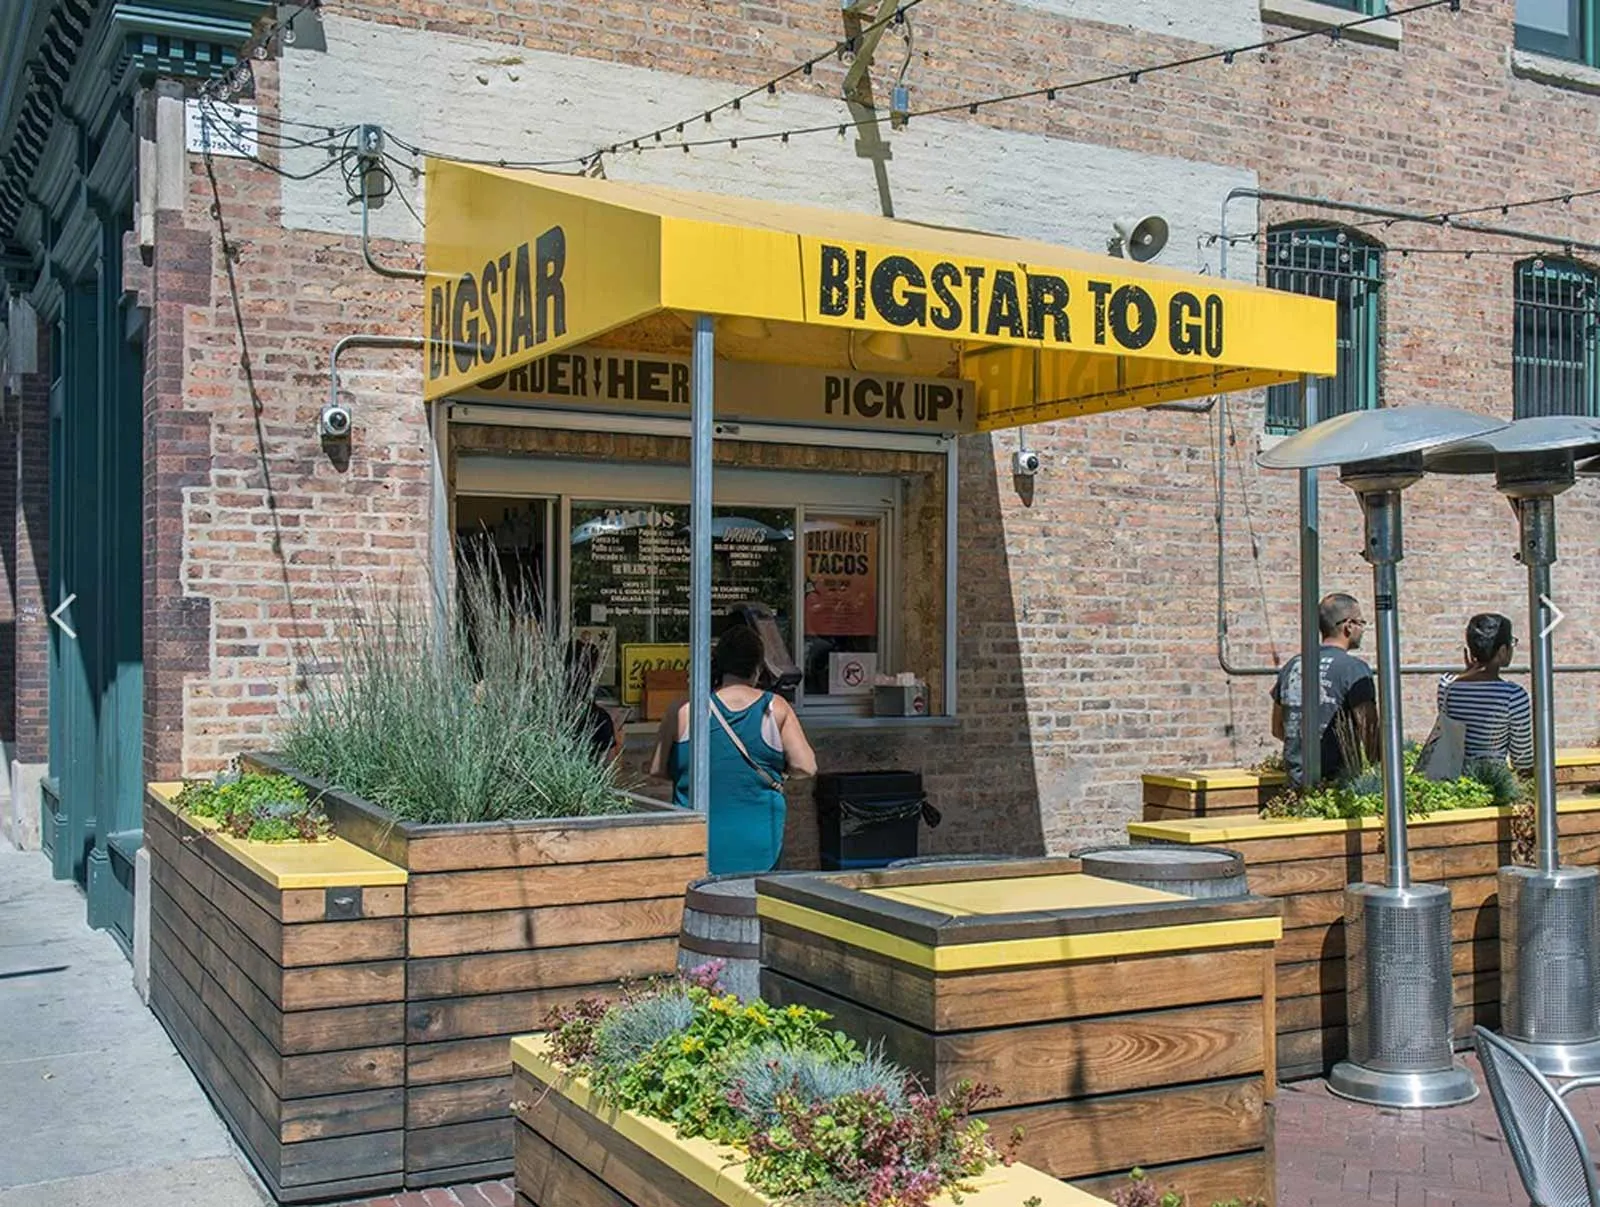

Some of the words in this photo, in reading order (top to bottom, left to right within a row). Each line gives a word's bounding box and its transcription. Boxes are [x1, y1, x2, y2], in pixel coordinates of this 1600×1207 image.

[429, 225, 566, 381] BIGSTAR
[820, 244, 1072, 344] BIGSTAR
[1088, 279, 1158, 350] TO
[1169, 290, 1224, 358] GO
[824, 375, 906, 420] PICK
[807, 530, 869, 553] BREAKFAST
[807, 553, 869, 576] TACOS
